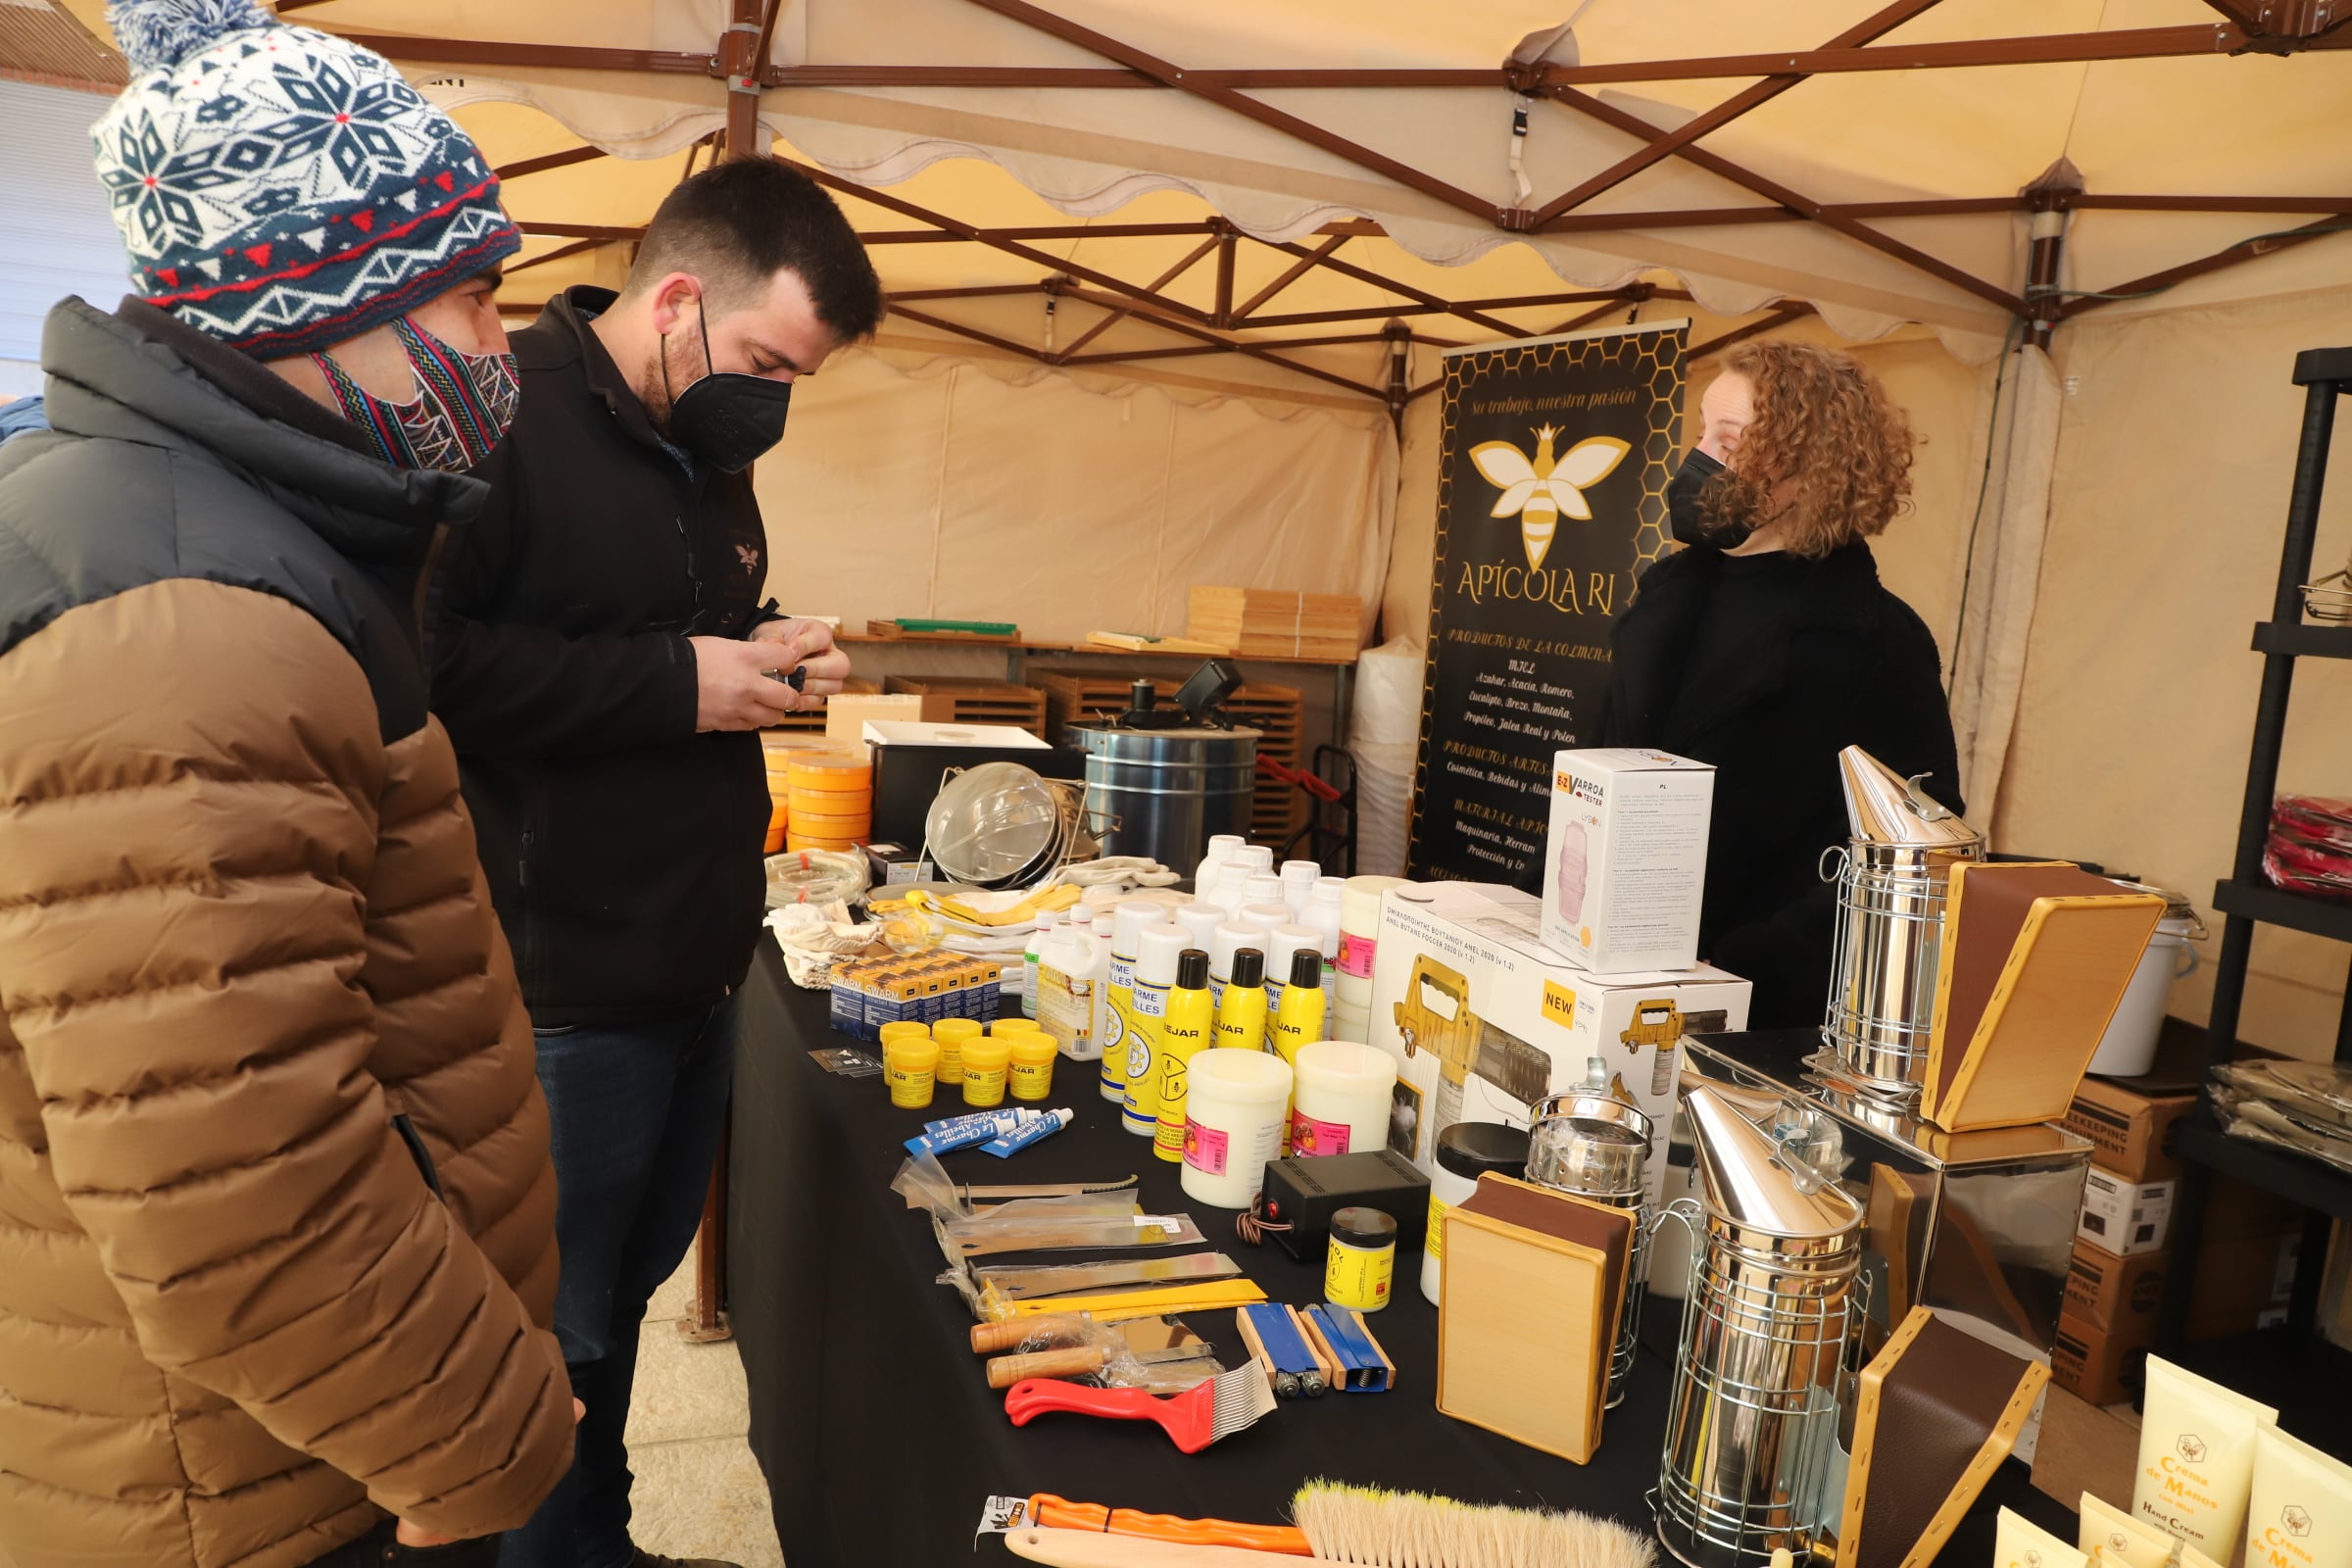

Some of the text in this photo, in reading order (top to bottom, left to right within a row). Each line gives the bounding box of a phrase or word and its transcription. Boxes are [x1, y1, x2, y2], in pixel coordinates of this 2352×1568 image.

[1537, 393, 1586, 411] nuestra
[1588, 386, 1637, 413] pasión
[1456, 558, 1584, 615] APÍCOLA
[1447, 628, 1614, 663] PRODUCTOS DE LA COLMENA
[1508, 659, 1536, 675] MIEL
[1496, 718, 1521, 732] Jalea
[1523, 723, 1544, 737] Real
[1443, 740, 1553, 776] PRODUCTOS ARTES
[1487, 771, 1519, 789] Bebidas
[1520, 781, 1528, 793] y
[1568, 774, 1604, 798] VARROA
[1583, 793, 1603, 808] TESTER
[1453, 799, 1514, 827] MATERIAL
[1466, 844, 1506, 866] Protección
[1503, 835, 1536, 856] Herram
[1386, 916, 1399, 928] ANEL
[1399, 922, 1422, 938] BUTANE
[1421, 932, 1444, 948] FOGGER
[1444, 943, 1457, 955] 2020
[1481, 949, 1495, 962] 2020
[832, 973, 862, 990] SWARM
[865, 984, 901, 1002] SWARM
[1545, 992, 1573, 1015] NEW
[983, 1122, 995, 1133] Le
[1047, 1114, 1057, 1124] Le
[2068, 1112, 2127, 1143] EEKEEPING
[941, 1127, 980, 1145] Charme
[1015, 1120, 1046, 1142] Charme
[2160, 1456, 2209, 1487] Crema
[2146, 1467, 2219, 1509] de Manos
[2142, 1500, 2204, 1540] Hand Cream
[2251, 1538, 2266, 1553] de
[2265, 1526, 2313, 1564] Crema
